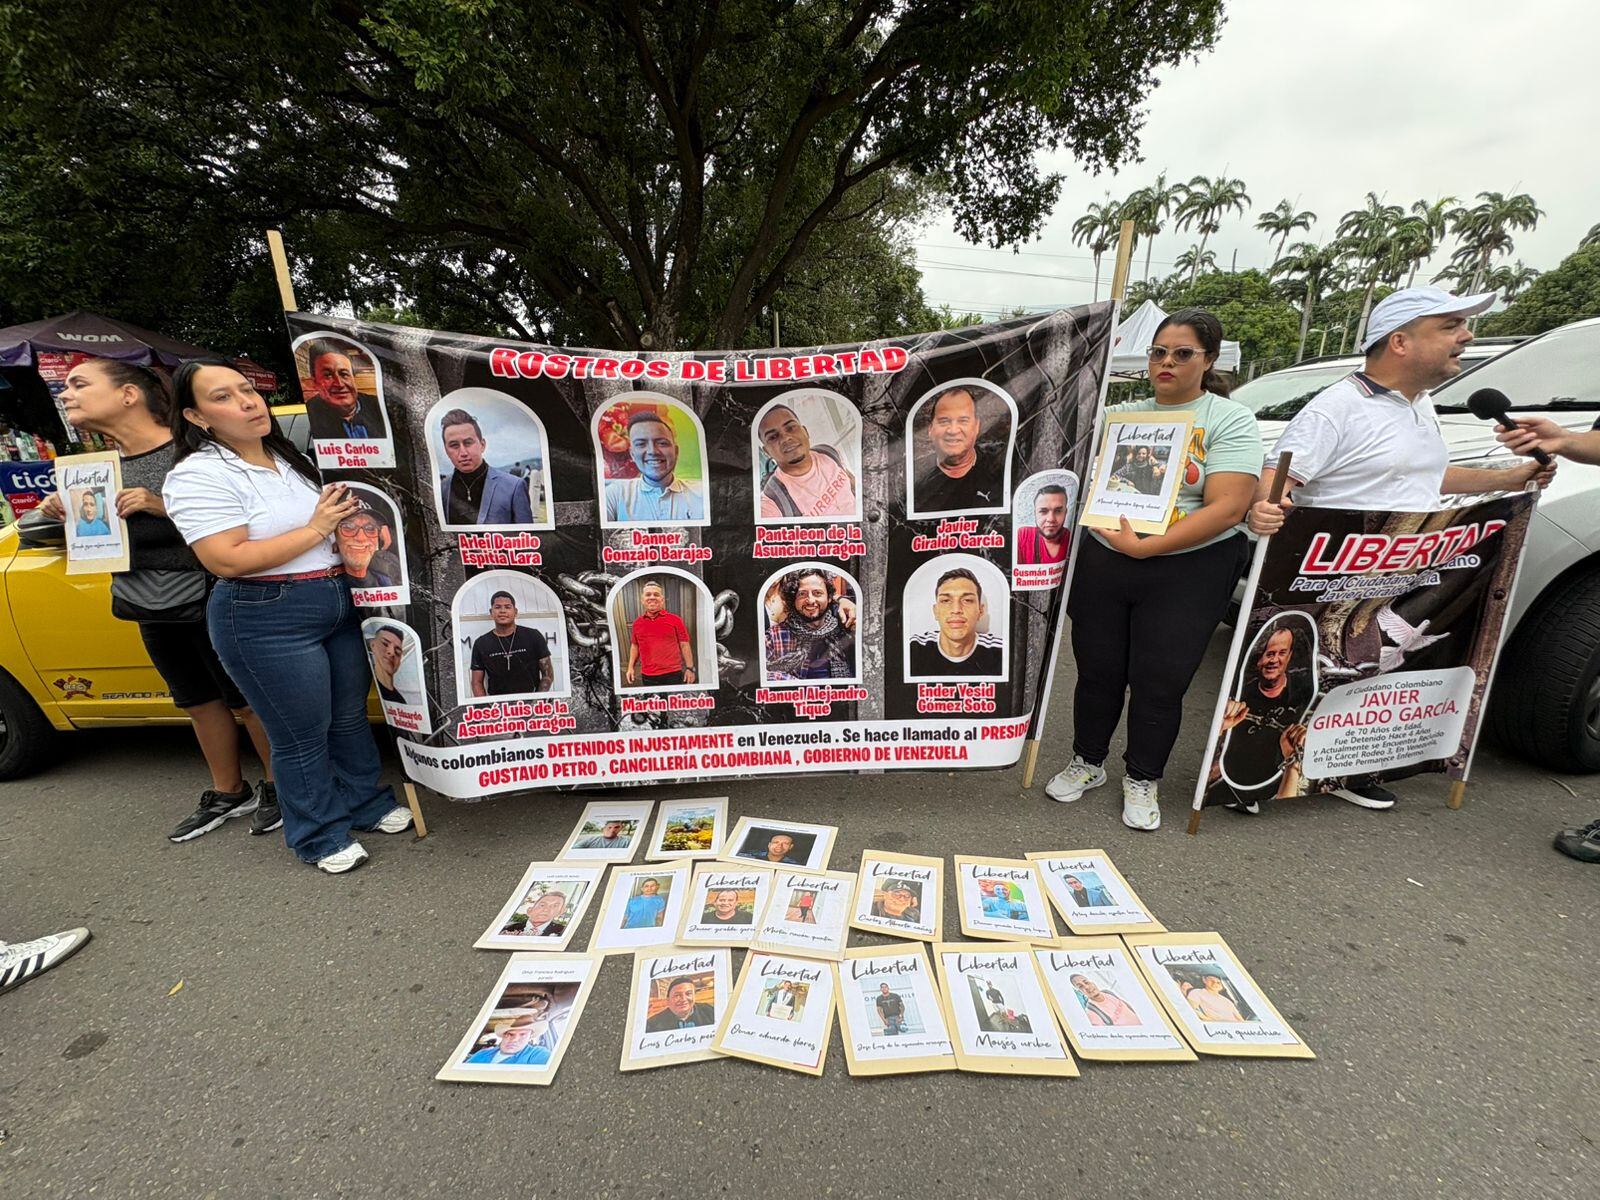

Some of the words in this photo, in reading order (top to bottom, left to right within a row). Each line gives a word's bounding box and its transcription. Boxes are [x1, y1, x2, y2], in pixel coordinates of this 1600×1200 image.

[57, 332, 123, 342] WOM
[490, 348, 671, 379] ROSTROS
[680, 360, 726, 382] DE
[734, 347, 910, 381] LIBERTAD
[1117, 424, 1176, 444] Libertad
[317, 443, 342, 455] Luis
[344, 443, 380, 455] Carlos
[338, 456, 367, 467] Peña
[64, 468, 110, 490] Libertad
[806, 470, 848, 517] URBERRY
[756, 525, 825, 542] Pantaleon
[827, 524, 845, 540] de
[847, 523, 862, 539] la
[937, 519, 978, 534] Javier
[458, 534, 491, 551] Arlei
[494, 532, 540, 550] Danilo
[632, 531, 681, 546] Danner
[911, 534, 960, 552] Giraldo
[960, 530, 1004, 548] García
[462, 550, 508, 568] Espitia
[510, 551, 542, 566] Lara
[603, 546, 657, 563] Gonzalo
[660, 545, 712, 565] Barajas
[753, 542, 817, 559] Asuncion
[818, 541, 866, 561] aragon
[1013, 567, 1047, 577] Gusmán
[1016, 577, 1049, 587] Ramírez
[1289, 577, 1327, 592] Para
[1327, 576, 1344, 590] el
[1344, 574, 1416, 589] Ciudadano
[363, 590, 398, 602] Cañas
[1316, 590, 1361, 602] Javier
[755, 687, 805, 704] Manuel
[806, 686, 868, 705] Alejandro
[917, 683, 956, 700] Ender
[956, 682, 996, 698] Yesid
[1354, 684, 1392, 694] Ciudadano
[1394, 679, 1443, 690] Colombiano
[620, 696, 666, 713] Martín
[668, 693, 714, 711] Rincón
[916, 697, 963, 714] Gómez
[964, 698, 996, 713] Soto
[1360, 690, 1419, 708] JAVIER
[464, 704, 501, 722] José
[503, 701, 532, 717] Luis
[534, 700, 552, 716] de
[554, 700, 569, 714] la
[793, 701, 831, 720] Tique
[457, 718, 528, 739] Asuncion
[528, 716, 576, 735] aragon
[1313, 710, 1392, 730] GIRALDO
[1334, 738, 1348, 746] Fue
[1350, 733, 1386, 745] Detenido
[1388, 731, 1407, 740] Hace
[1345, 729, 1356, 737] de
[1358, 727, 1369, 735] 70
[1370, 725, 1390, 734] Años
[1392, 724, 1402, 732] de
[440, 747, 544, 769] colombianos
[548, 738, 625, 758] DETENIDOS
[629, 733, 734, 753] INJUSTAMENTE
[737, 734, 755, 747] en
[758, 729, 831, 746] Venezuela
[842, 729, 861, 742] Se
[864, 728, 899, 742] hace
[903, 726, 960, 741] llamado
[964, 727, 977, 740] al
[1321, 743, 1370, 755] Actualmente
[1335, 750, 1359, 760] Cárcel
[1361, 747, 1385, 757] Rodeo
[479, 764, 549, 788] GUSTAVO
[552, 760, 598, 779] PETRO
[609, 753, 696, 774] CANCILLERÍA
[701, 750, 792, 770] COLOMBIANA
[804, 748, 871, 764] GOBIERNO
[874, 748, 891, 762] DE
[894, 745, 969, 761] VENEZUELA
[1327, 759, 1353, 769] Donde
[1355, 754, 1395, 766] Permanece
[872, 862, 931, 880] Libertad
[972, 865, 1030, 880] Libertad
[1048, 861, 1095, 872] Libertad
[705, 873, 760, 888] Libertad
[786, 875, 839, 892] Libertad
[958, 953, 1018, 972] Libertad
[1050, 953, 1115, 971] Libertad
[1152, 947, 1216, 965] Libertad
[650, 955, 715, 978] Libertad
[761, 959, 821, 982] Libertad
[852, 957, 918, 980] Libertad
[639, 1037, 660, 1050] Luis
[665, 1033, 695, 1047] Carlos
[699, 1029, 715, 1044] peñ
[731, 1024, 755, 1035] Omar
[758, 1030, 790, 1042] eduardo
[792, 1036, 816, 1050] flores
[1203, 1024, 1233, 1039] Luis
